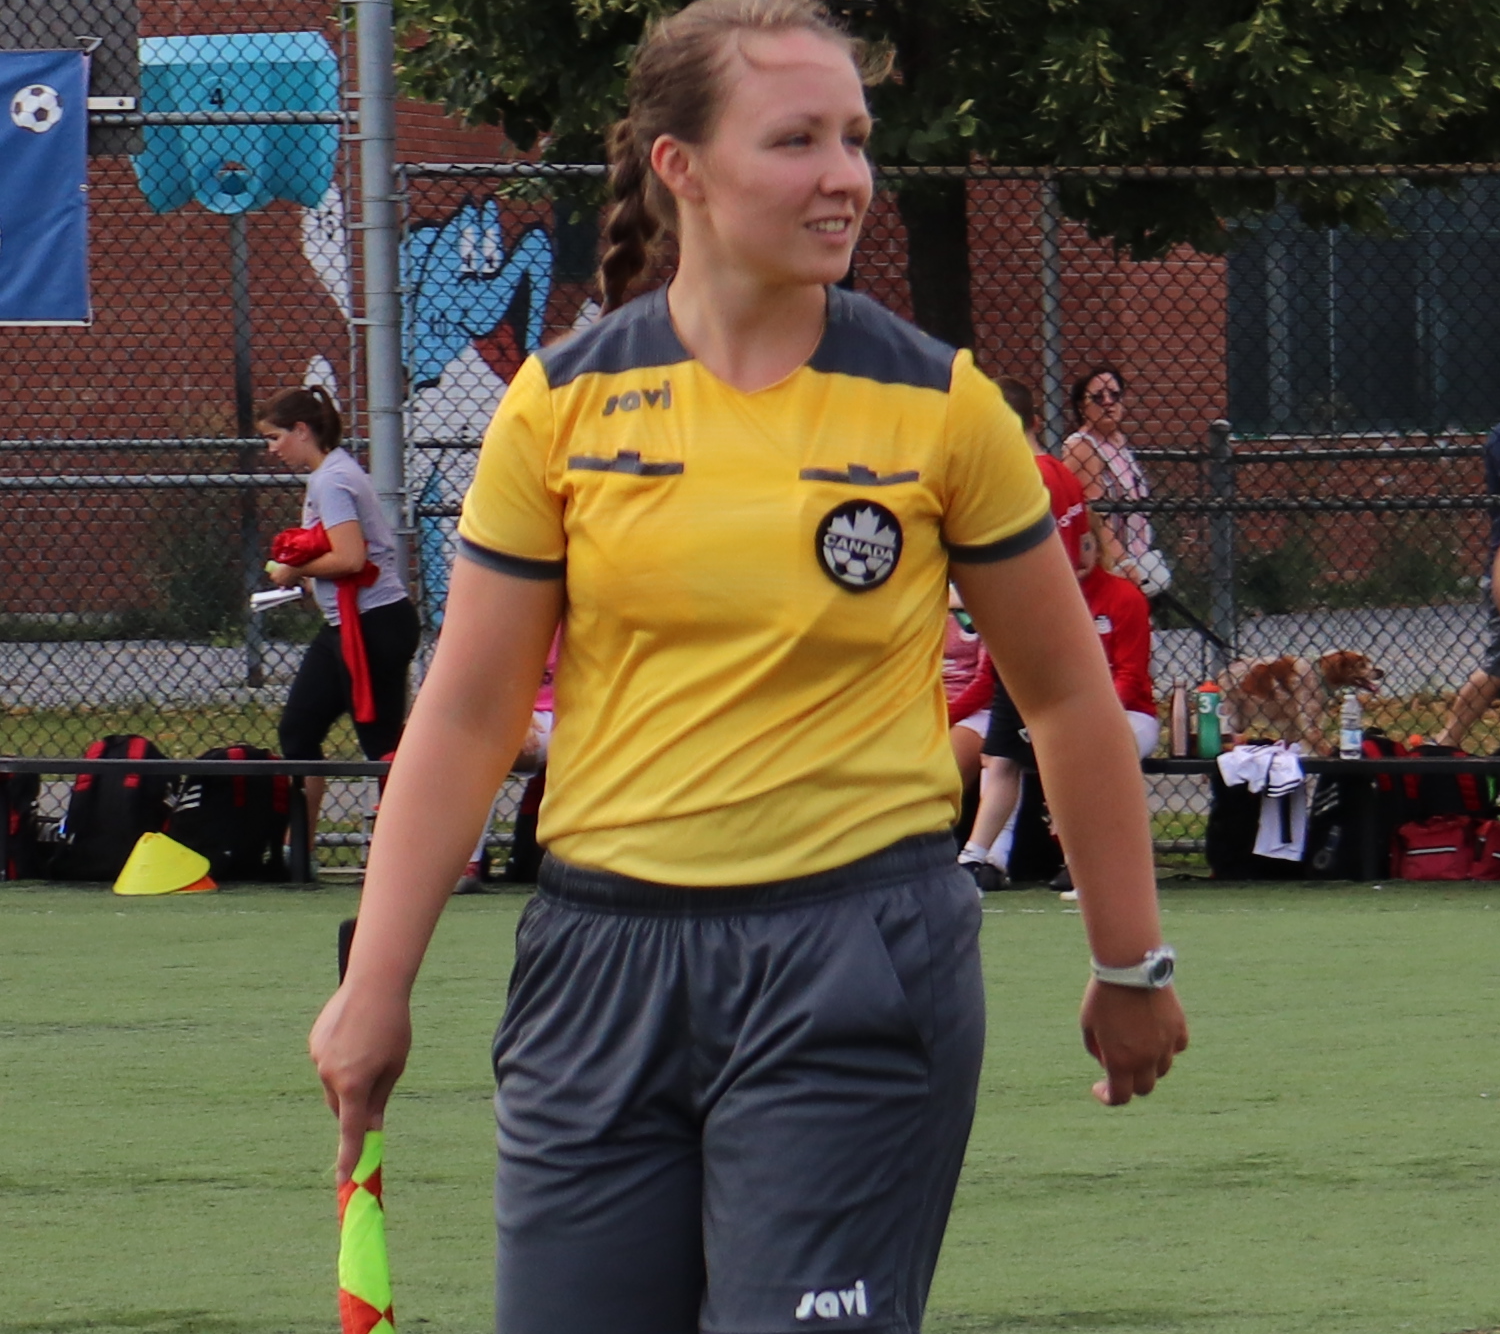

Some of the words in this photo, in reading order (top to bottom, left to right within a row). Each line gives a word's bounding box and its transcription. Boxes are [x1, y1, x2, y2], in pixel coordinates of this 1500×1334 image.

[602, 381, 671, 416] savi
[824, 534, 894, 562] CANADA
[795, 1280, 867, 1320] savi
